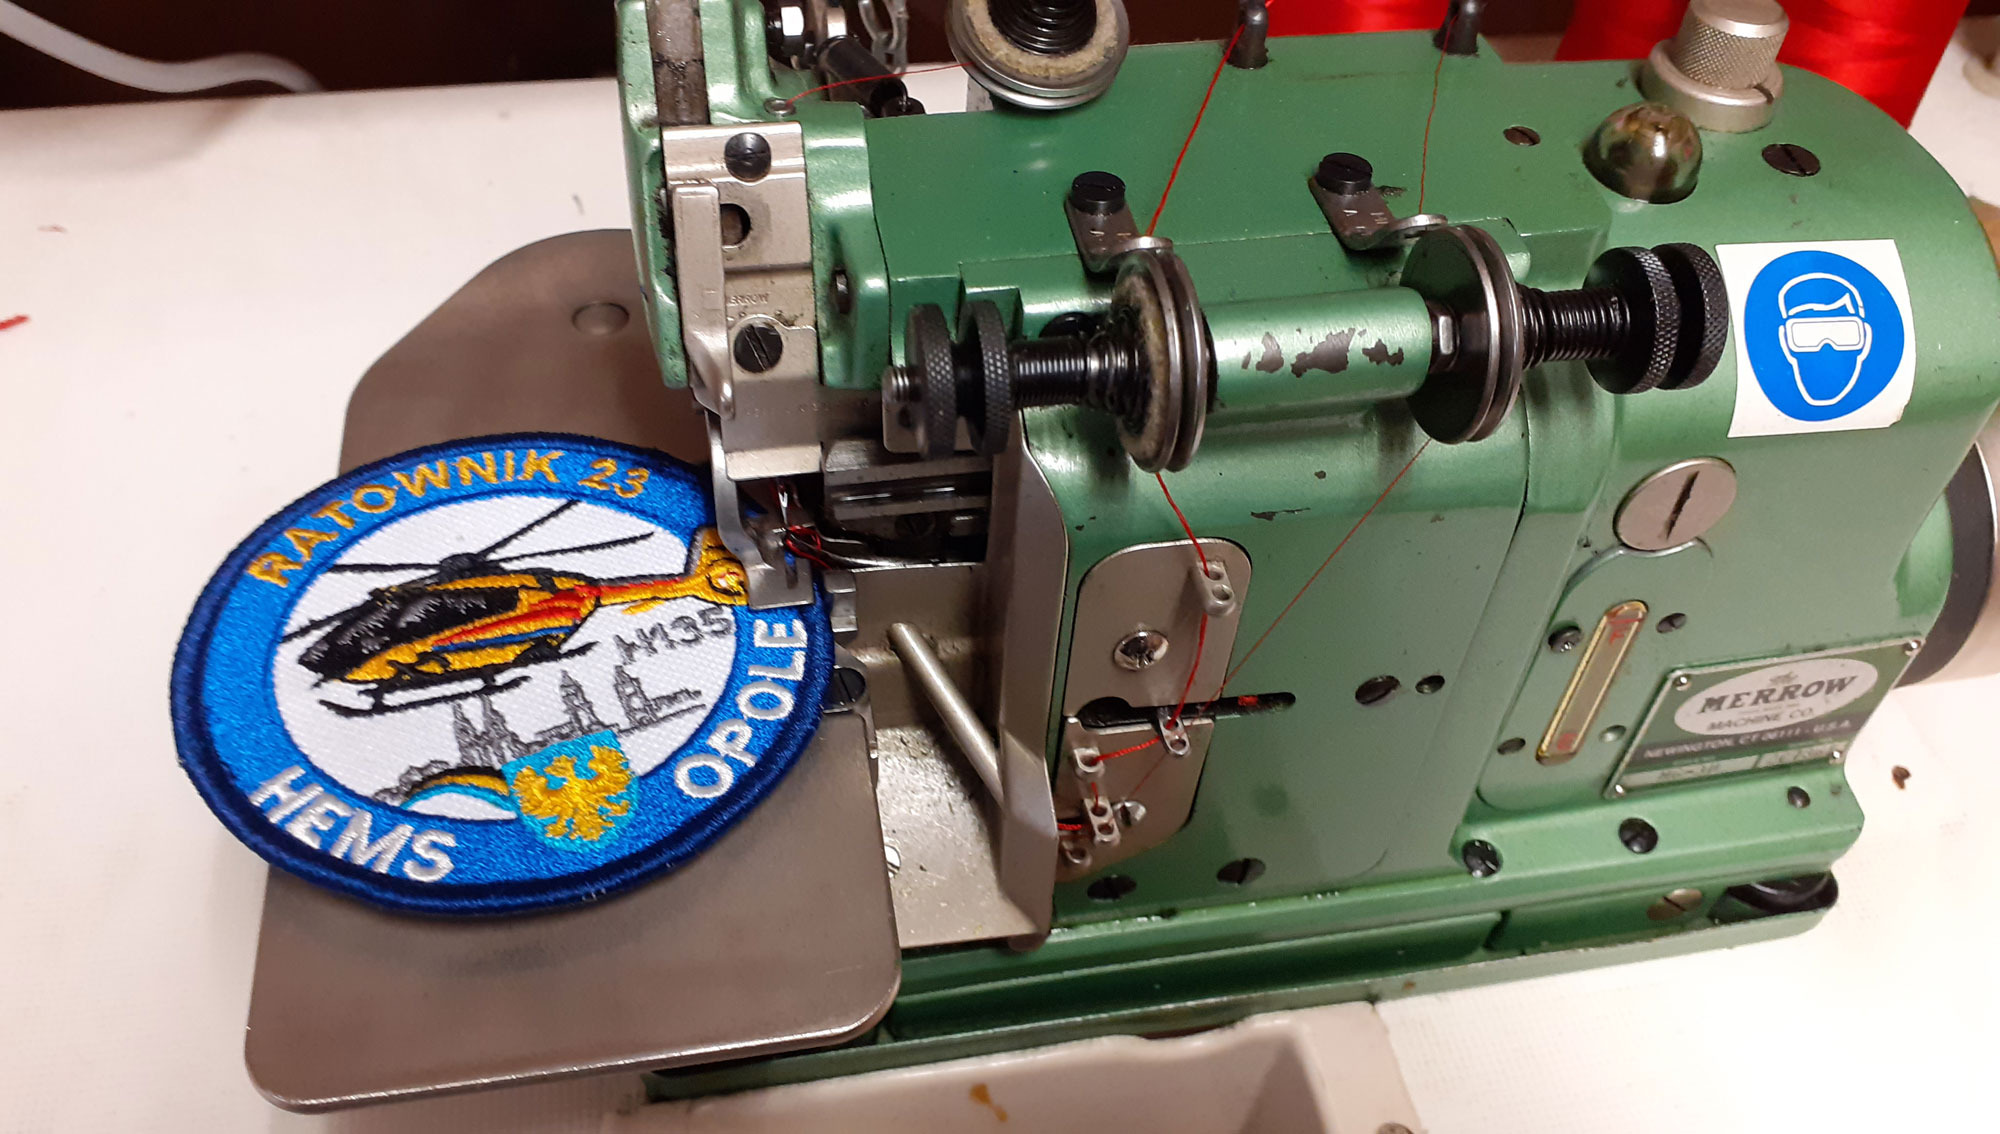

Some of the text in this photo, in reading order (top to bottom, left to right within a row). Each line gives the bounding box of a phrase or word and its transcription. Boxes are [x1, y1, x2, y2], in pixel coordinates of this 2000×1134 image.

[727, 292, 770, 306] ERROW
[246, 450, 651, 587] RATOWNIK 23
[673, 618, 809, 799] OPOLE
[1697, 675, 1858, 713] MERROW
[1707, 712, 1782, 730] MACHINE
[250, 764, 458, 883] HEMS
